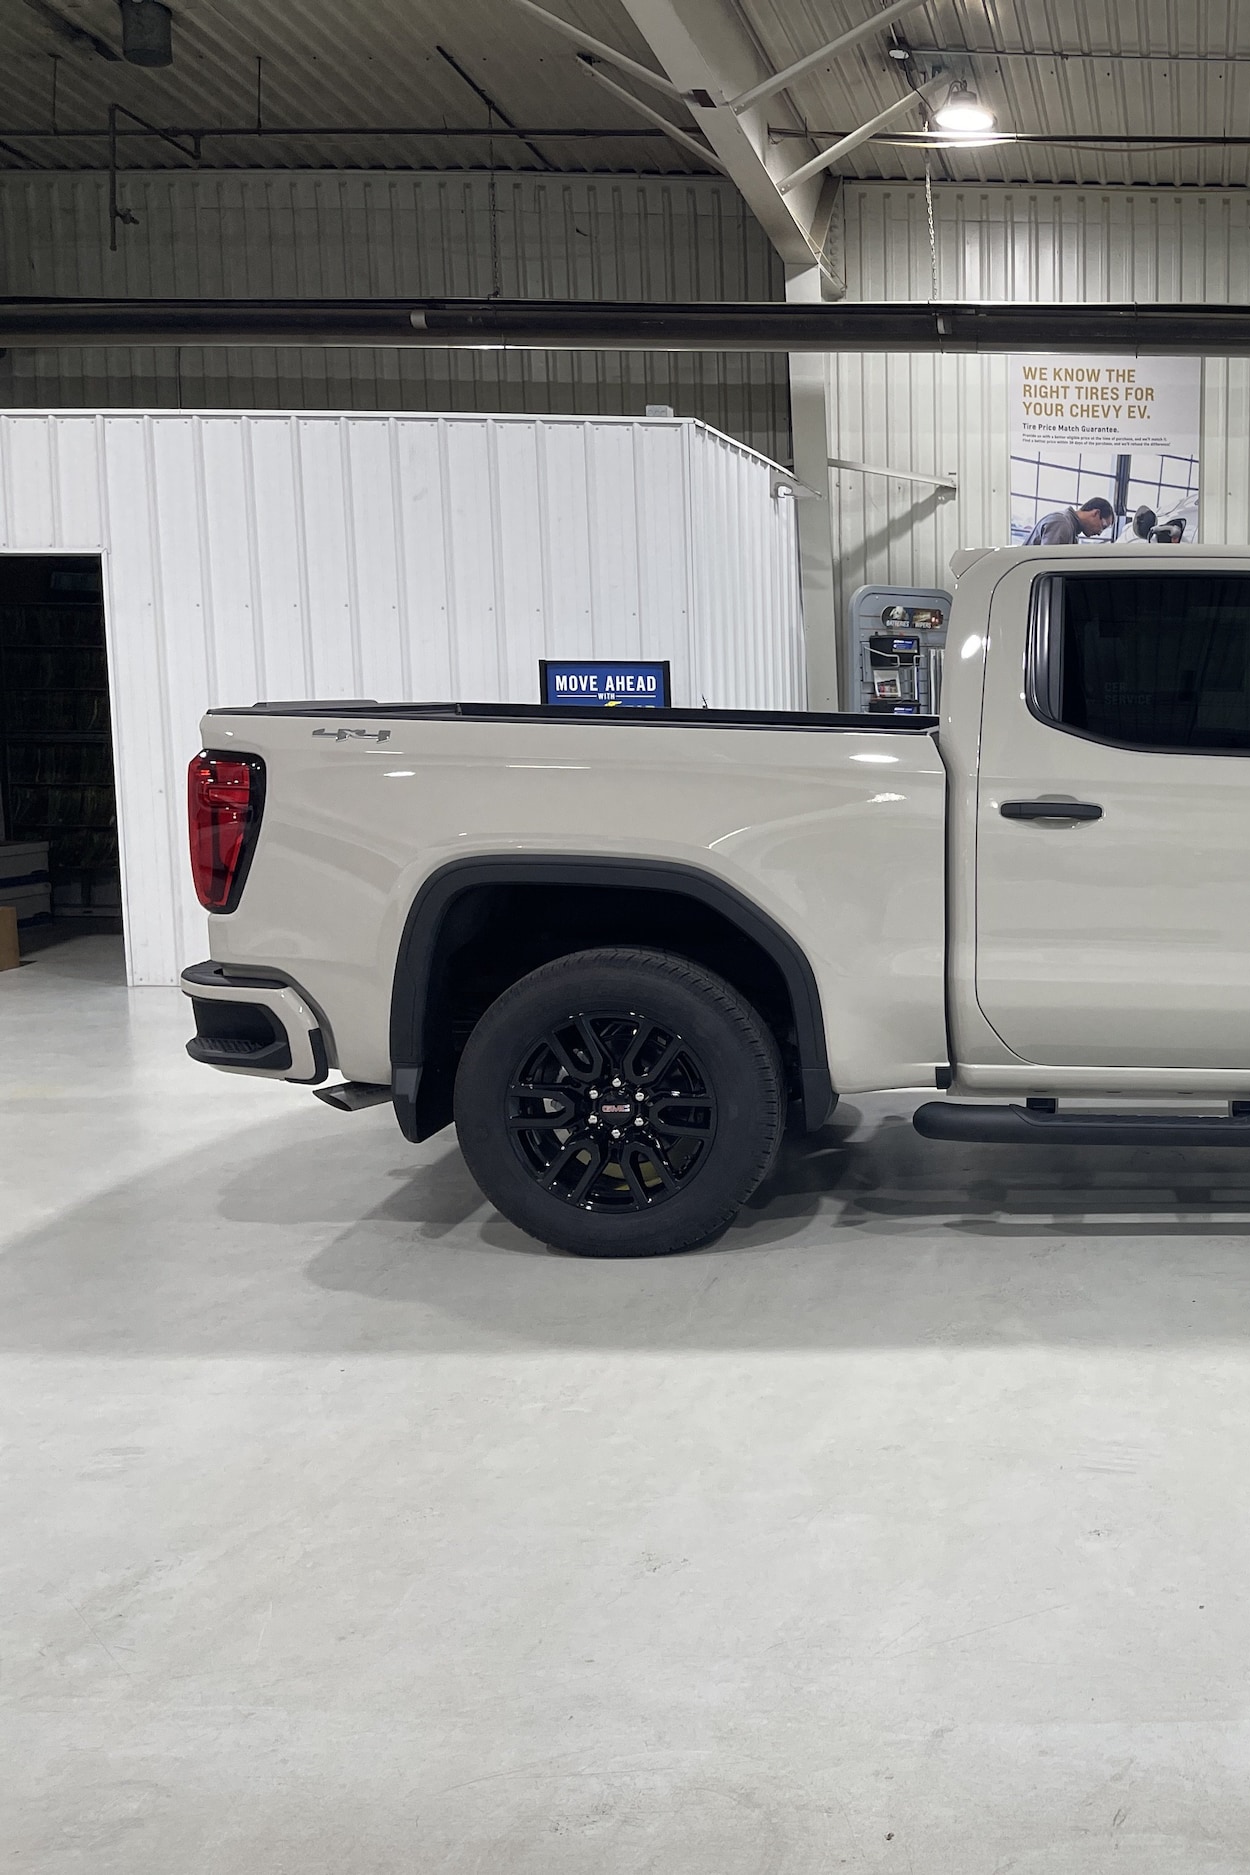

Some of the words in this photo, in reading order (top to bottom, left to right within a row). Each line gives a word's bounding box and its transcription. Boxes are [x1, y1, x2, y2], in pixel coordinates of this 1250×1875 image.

[1022, 366, 1048, 381] WE
[1053, 367, 1101, 383] KNOW
[1105, 368, 1136, 383] THE
[1023, 384, 1070, 400] RIGHT
[1074, 386, 1119, 401] TIRES
[1125, 387, 1155, 401] FOR
[1022, 401, 1065, 417] YOUR
[1069, 403, 1123, 419] CHEVY
[1127, 405, 1151, 419] EV.
[1022, 422, 1037, 431] Tire
[1038, 423, 1057, 432] Price
[1058, 424, 1080, 432] Match
[1081, 425, 1119, 433] Guarantee.
[555, 675, 599, 692] MOVE
[605, 675, 657, 692] AHEAD
[597, 692, 616, 700] WITH
[601, 1104, 631, 1113] GMC
